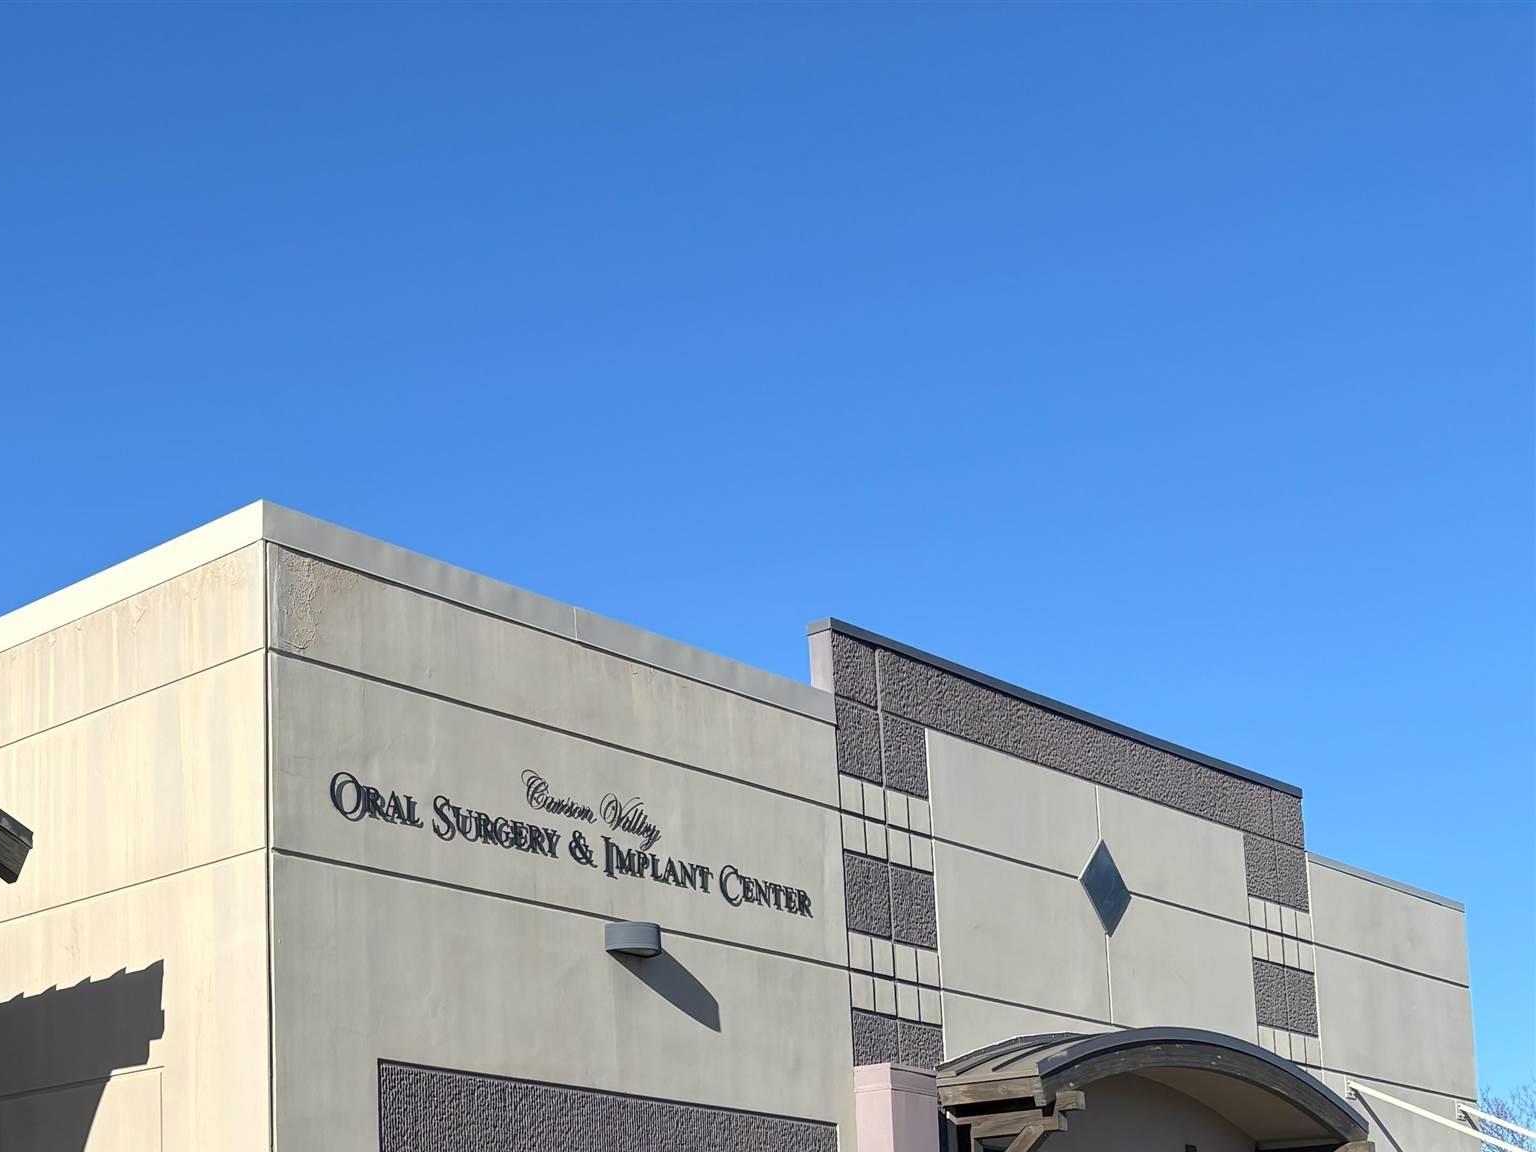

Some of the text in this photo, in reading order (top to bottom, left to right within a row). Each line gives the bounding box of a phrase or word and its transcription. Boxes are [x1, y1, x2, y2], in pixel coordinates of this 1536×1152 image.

[329, 771, 815, 919] ORAL SURGERY & IMPLANT CENTER
[521, 769, 661, 851] Carson Valley
